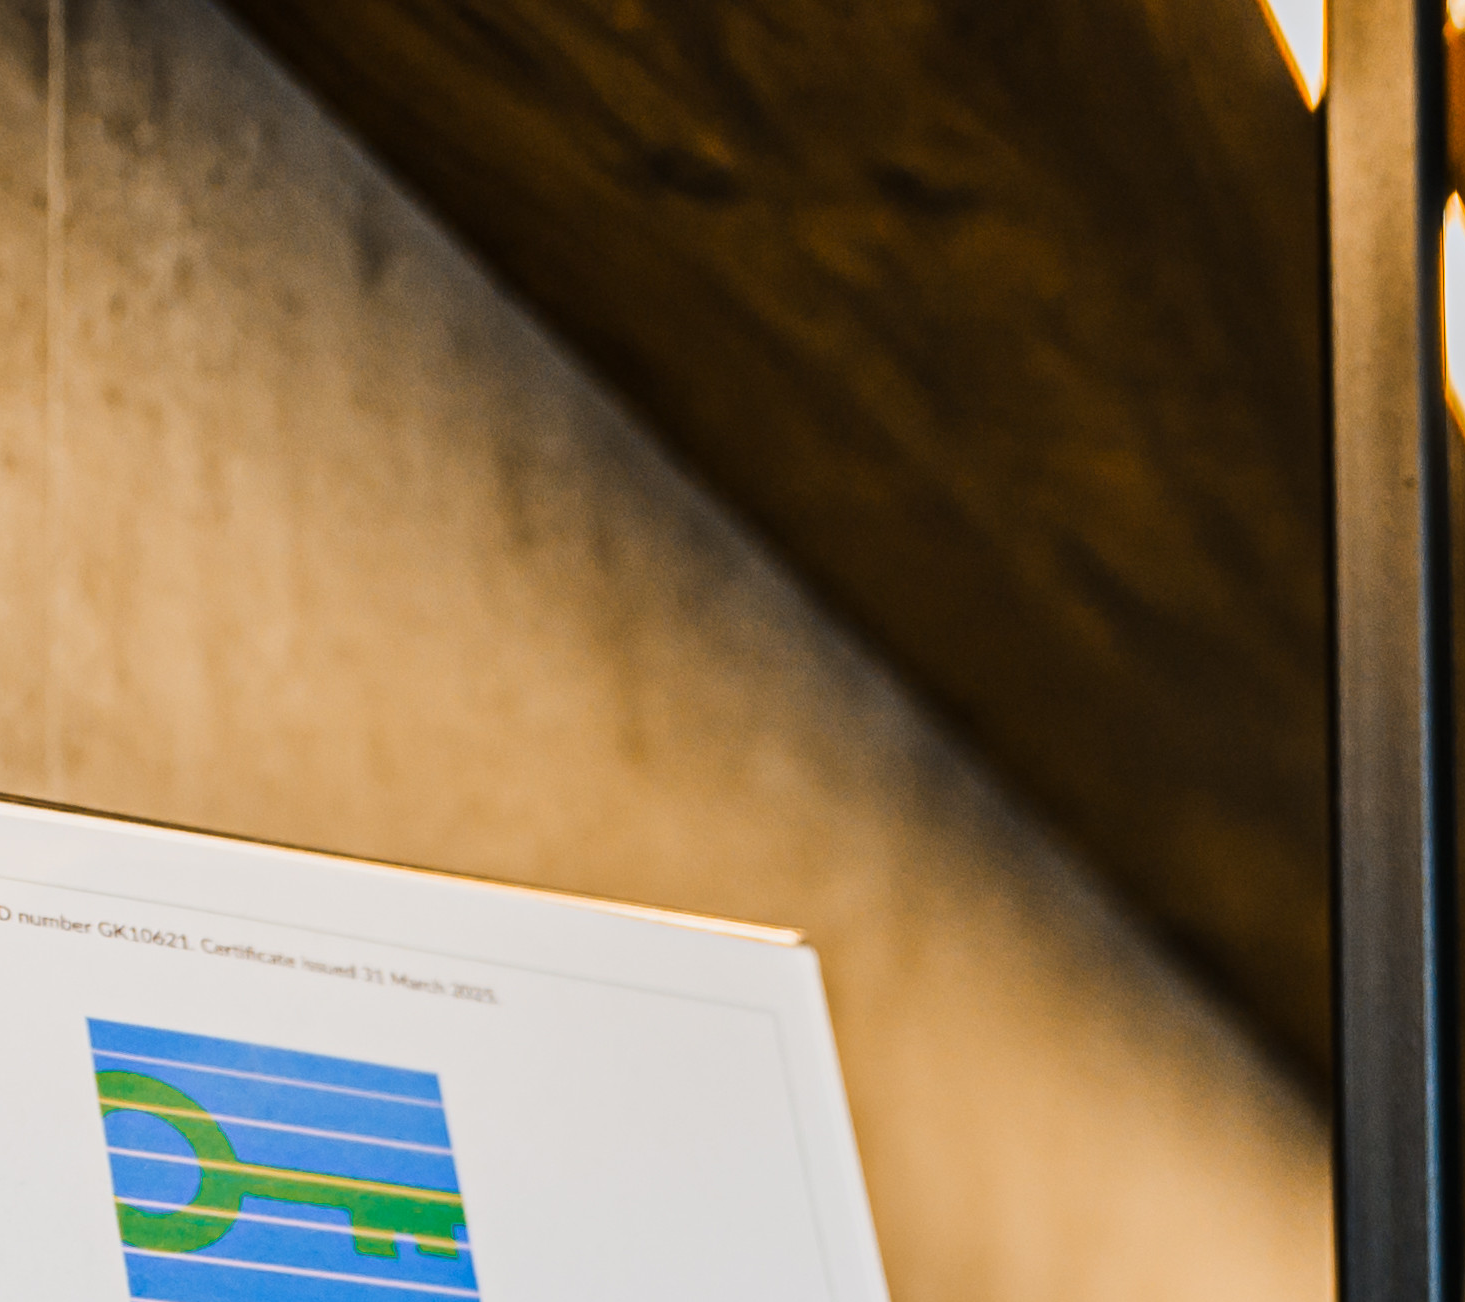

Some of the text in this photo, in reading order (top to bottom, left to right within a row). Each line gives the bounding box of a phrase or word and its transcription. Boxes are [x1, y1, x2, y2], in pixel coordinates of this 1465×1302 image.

[17, 911, 93, 935] number
[199, 937, 298, 969] Certificate
[389, 971, 446, 995] March
